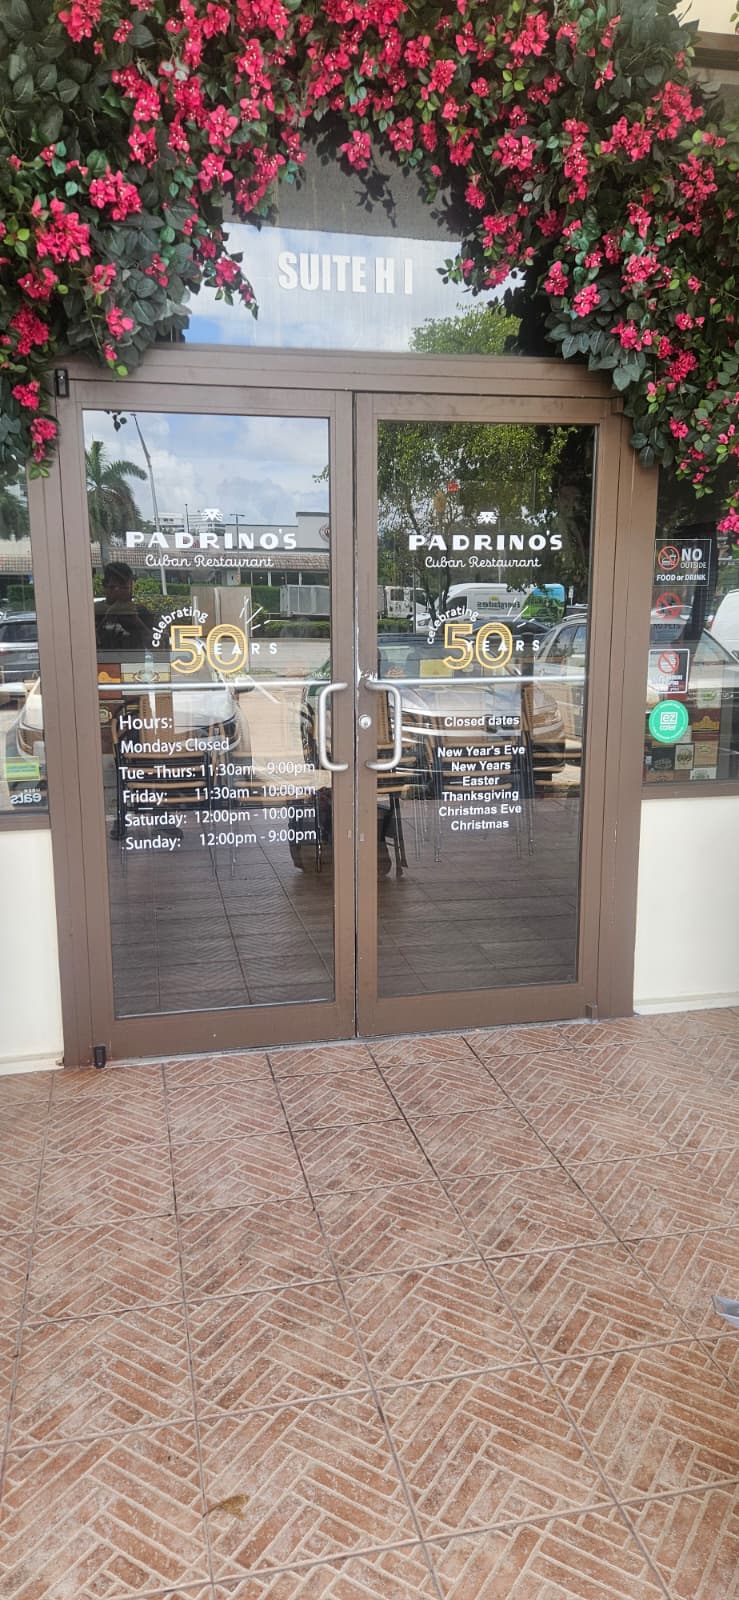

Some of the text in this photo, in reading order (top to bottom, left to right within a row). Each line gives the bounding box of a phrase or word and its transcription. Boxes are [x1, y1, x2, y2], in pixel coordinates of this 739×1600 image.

[278, 251, 413, 295] SUITE H I
[125, 528, 297, 550] PADRINO'S
[409, 530, 562, 551] PADRINO'S
[145, 554, 275, 568] Cuban Restaurant
[425, 556, 542, 568] Cuban Restaurant
[681, 548, 703, 561] NO
[151, 607, 209, 648] celebrating
[427, 605, 480, 645] celebrating
[170, 623, 248, 674] 50
[195, 642, 278, 655] YEARS
[443, 621, 513, 670] 50
[466, 640, 540, 652] YEARS
[119, 715, 173, 731] Hours:
[444, 715, 520, 727] Closed dates
[121, 737, 230, 755] Mondays Closed
[437, 744, 525, 757] New Year's Eve
[119, 766, 145, 780] Tue
[154, 764, 196, 779] Thurs:
[200, 763, 256, 777] 11:30am
[267, 761, 315, 776] 9:00pm
[451, 760, 511, 772] New Years
[463, 776, 500, 786] Easter
[123, 790, 168, 805] Friday:
[194, 787, 250, 801] 11:30am
[262, 784, 316, 799] 10:00pm
[441, 790, 519, 803] Thanksgiving
[124, 812, 187, 828] Saturday:
[194, 810, 250, 825] 12:00pm
[262, 807, 316, 822] 10:00pm
[438, 804, 522, 817] Christmas Eve
[451, 820, 509, 831] Christmas
[126, 836, 181, 852] Sunday:
[199, 832, 256, 847] 12:00pm
[268, 829, 317, 844] 9:00pm
